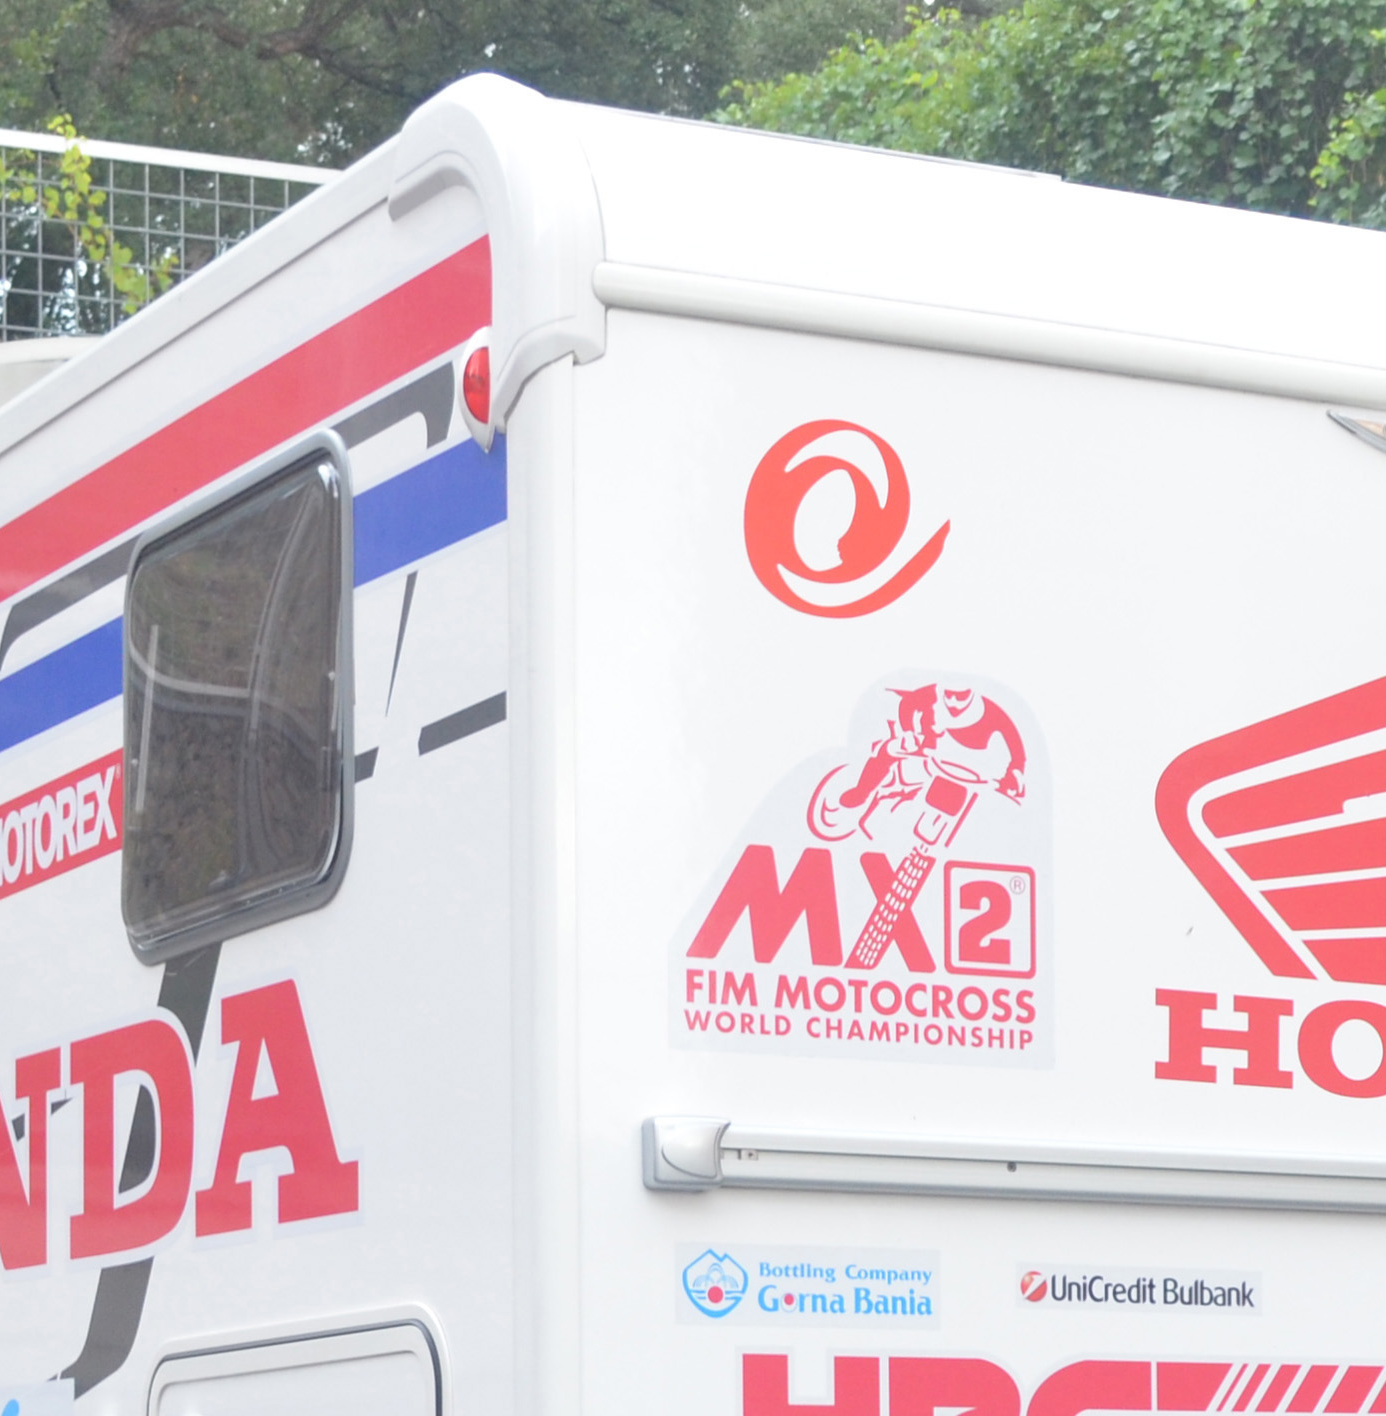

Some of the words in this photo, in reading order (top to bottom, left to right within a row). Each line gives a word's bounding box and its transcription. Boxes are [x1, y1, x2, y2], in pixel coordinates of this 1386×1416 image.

[686, 968, 758, 1007] FIM
[774, 974, 1037, 1025] MOTOCROSS
[683, 1008, 792, 1037] WORLD
[806, 1016, 1034, 1051] CHAMPIONSHIP
[758, 1261, 837, 1284] Bottling
[844, 1263, 933, 1286] Company
[853, 1286, 933, 1317] Bania
[1050, 1274, 1157, 1305] UniCredit
[1162, 1277, 1255, 1308] Bulbank
